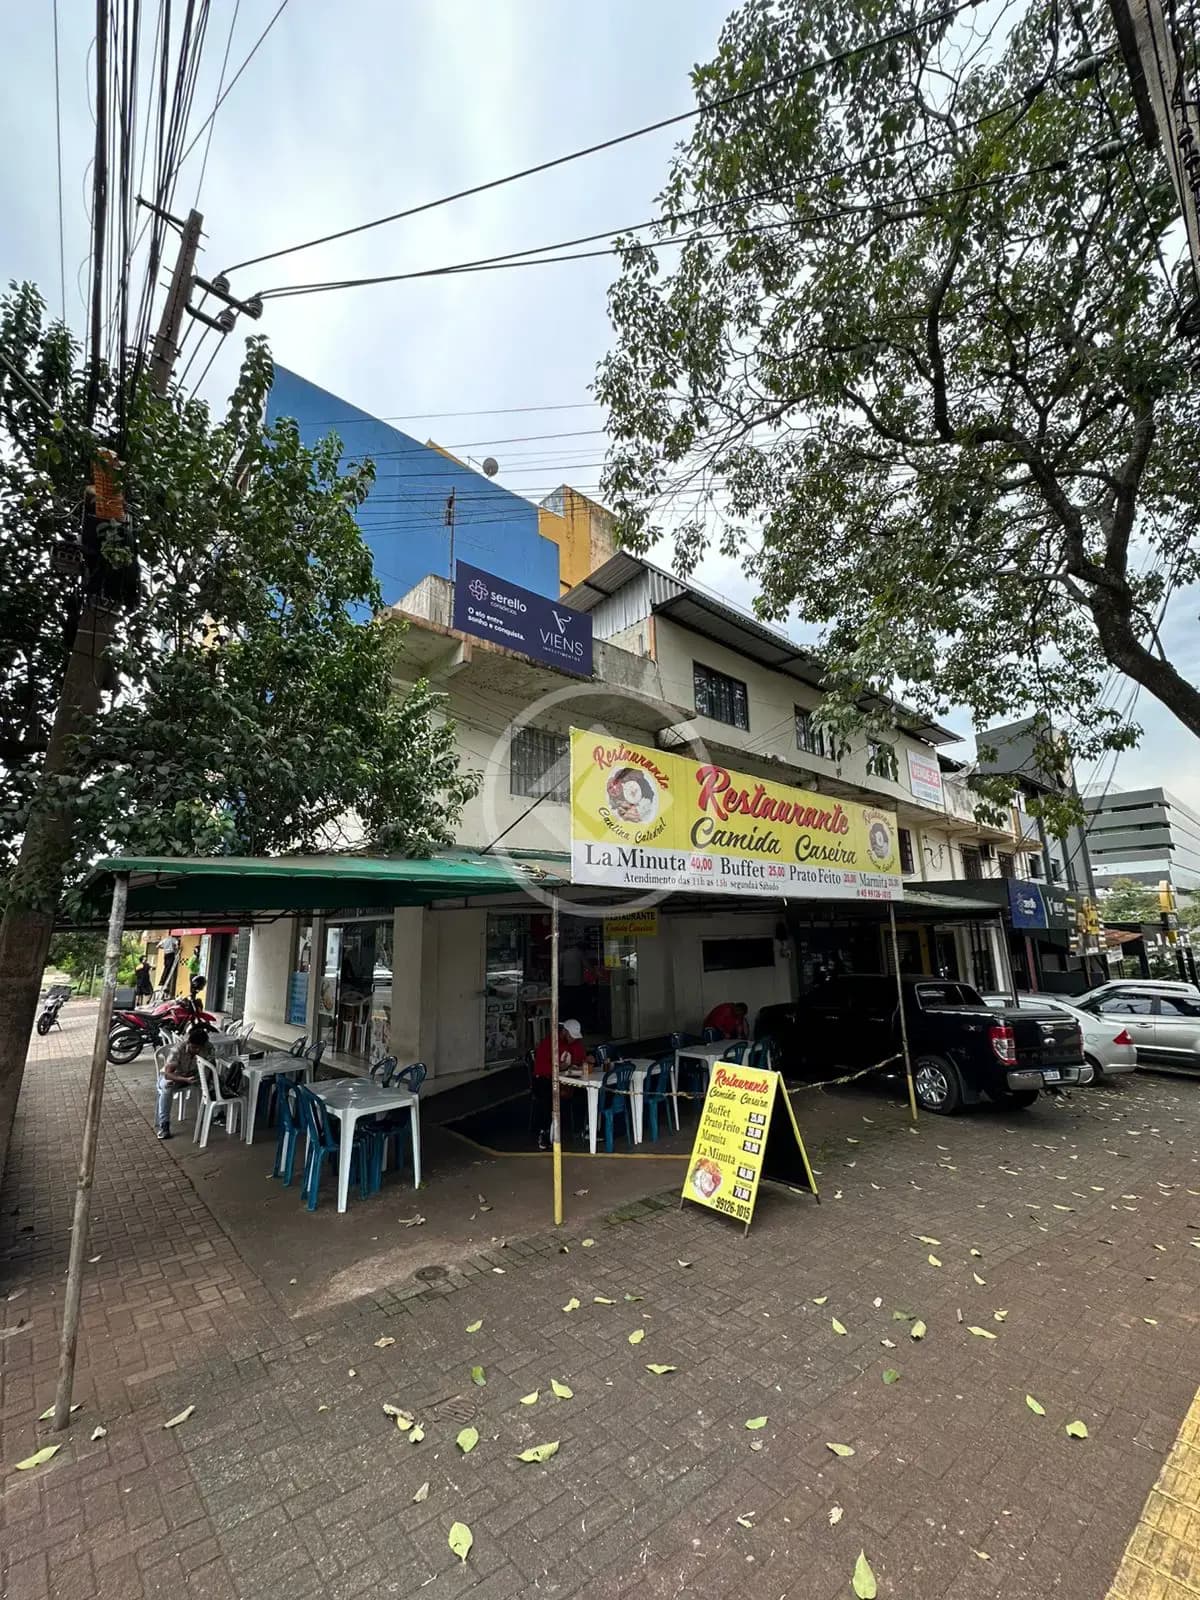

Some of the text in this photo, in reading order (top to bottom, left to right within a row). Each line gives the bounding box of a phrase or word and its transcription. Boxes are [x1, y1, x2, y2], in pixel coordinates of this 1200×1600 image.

[490, 591, 527, 613] serello
[467, 606, 504, 625] O elo entre
[467, 615, 488, 627] sonho
[494, 625, 526, 641] conquista.
[539, 628, 584, 656] VIENS
[592, 743, 670, 791] Restaurante
[695, 764, 850, 835] Restaurante
[598, 807, 630, 840] Cantina
[794, 834, 857, 865] Caseira
[585, 843, 612, 867] La
[617, 847, 686, 872] Minuta
[690, 857, 713, 873] 40,00
[720, 857, 765, 878] Buffet
[768, 865, 785, 878] 25,00
[789, 864, 817, 882] Prato
[818, 868, 841, 885] Feito
[859, 873, 888, 889] Marmita
[623, 872, 676, 885] Atendimento
[677, 875, 691, 885] das
[692, 877, 705, 887] 11h
[605, 911, 656, 921] RESTAURANTE
[714, 1068, 769, 1094] Restaurante
[707, 1102, 731, 1118] Buffet
[703, 1114, 722, 1129] Prato
[722, 1119, 741, 1135] Feito
[701, 1128, 727, 1146] Marmita
[697, 1143, 707, 1156] La
[707, 1146, 737, 1166] Minuta
[715, 1196, 751, 1220] 99126-1015
